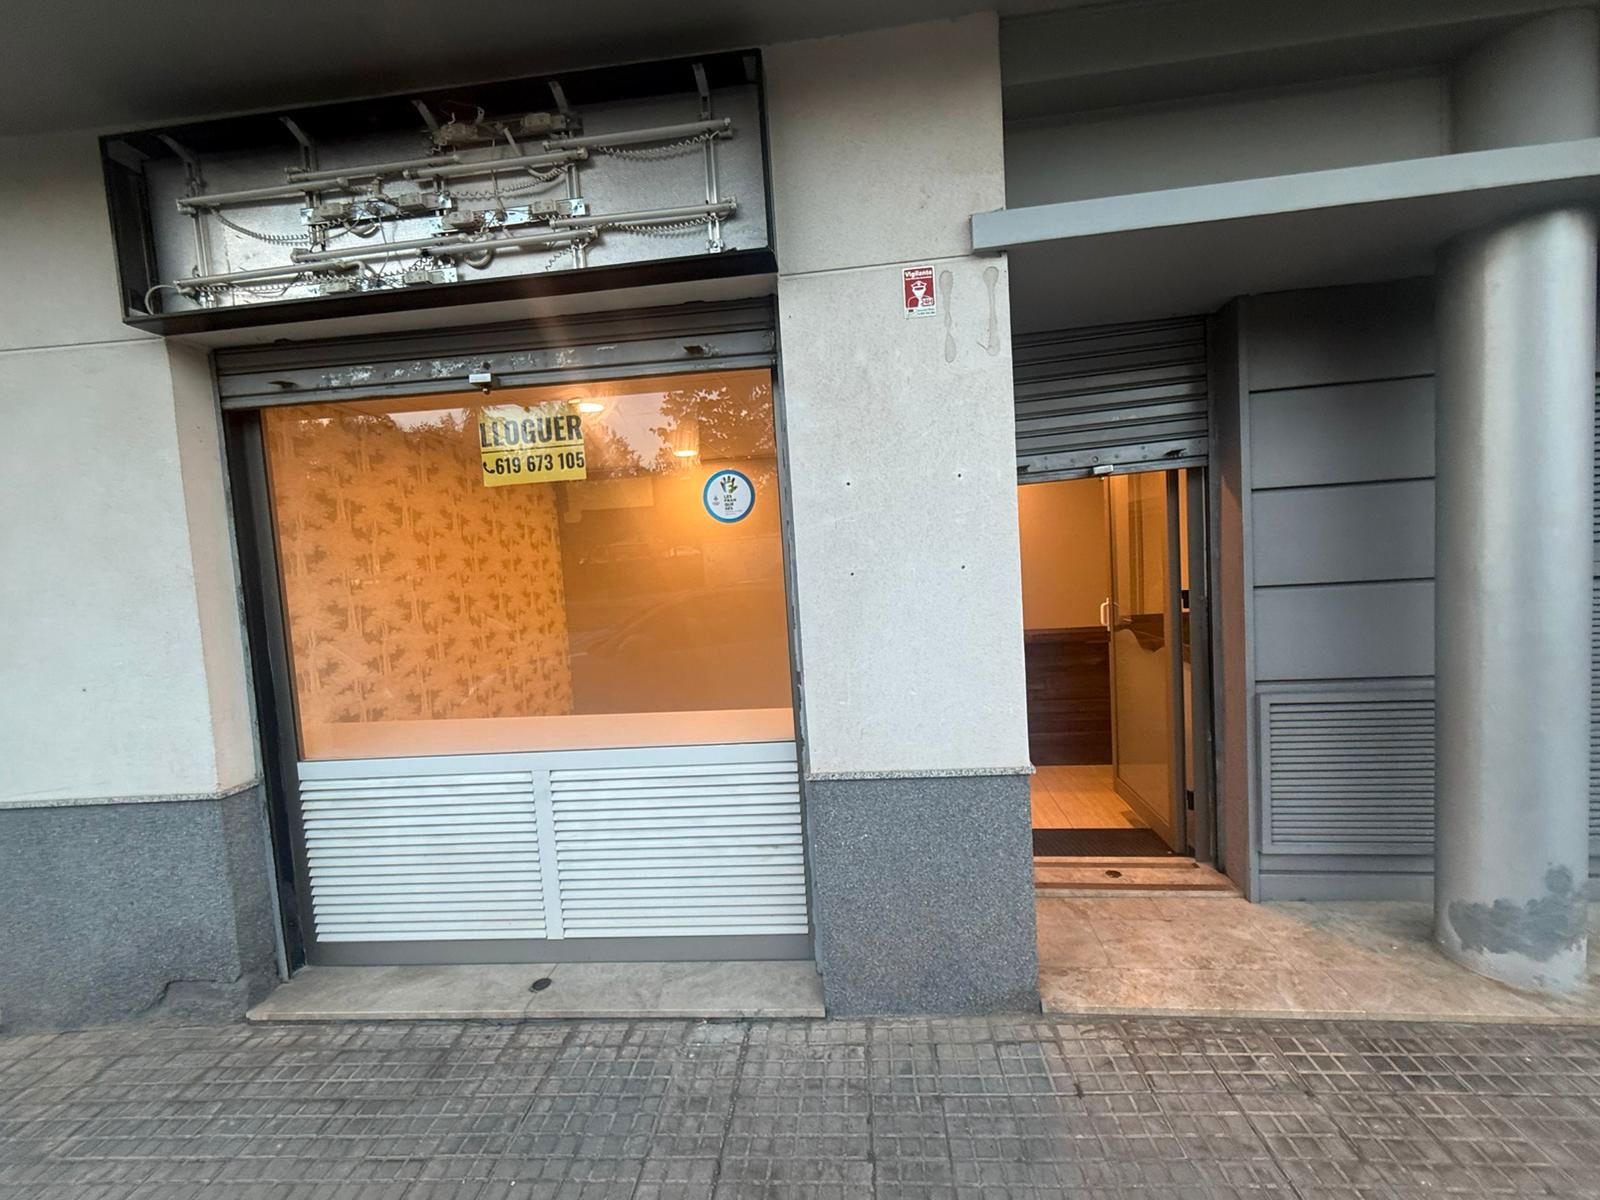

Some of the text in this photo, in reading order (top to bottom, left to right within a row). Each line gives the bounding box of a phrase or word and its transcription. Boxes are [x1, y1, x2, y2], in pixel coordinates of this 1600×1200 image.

[905, 270, 932, 278] Vigilante
[480, 415, 582, 448] LLOGUER
[495, 452, 584, 475] 619 673 105
